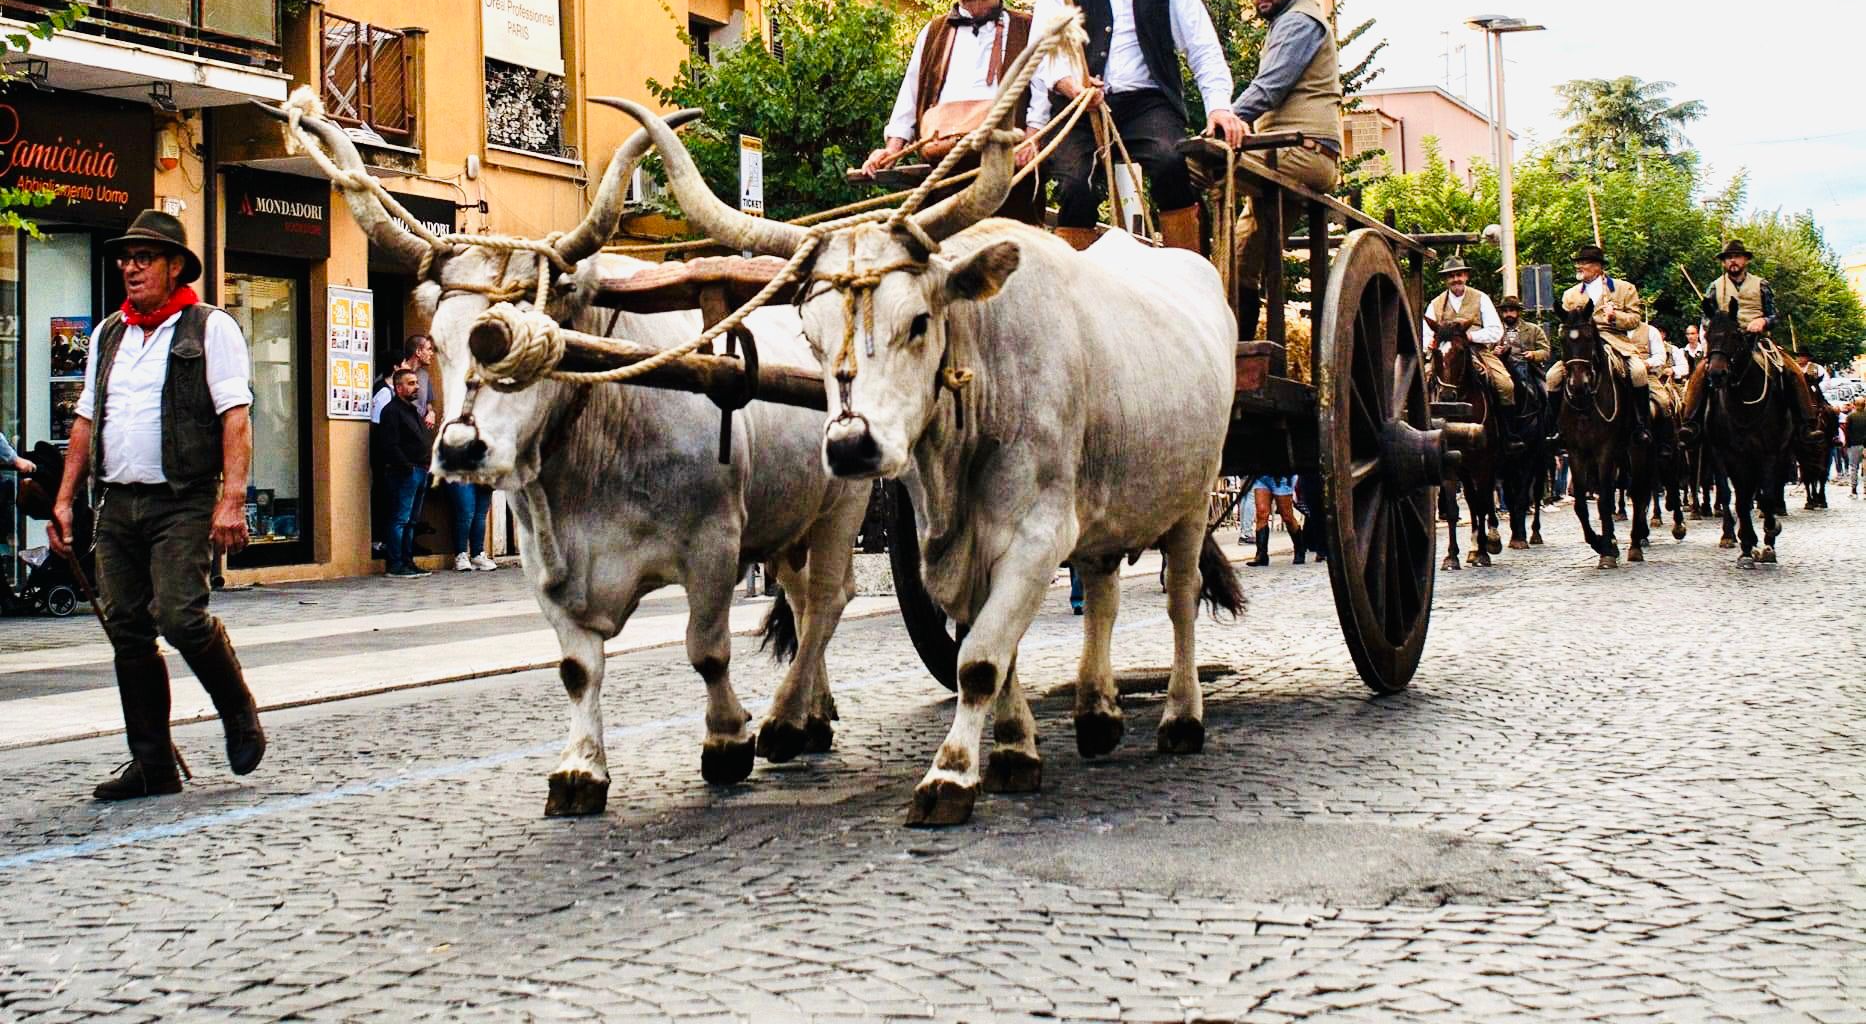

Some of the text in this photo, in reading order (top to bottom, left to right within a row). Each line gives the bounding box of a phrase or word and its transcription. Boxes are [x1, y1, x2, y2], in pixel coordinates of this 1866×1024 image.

[507, 0, 554, 26] Professionnel
[507, 20, 529, 41] PARIS
[96, 185, 129, 205] Uomo
[743, 199, 761, 208] TICKET
[255, 197, 323, 221] MONDADORI
